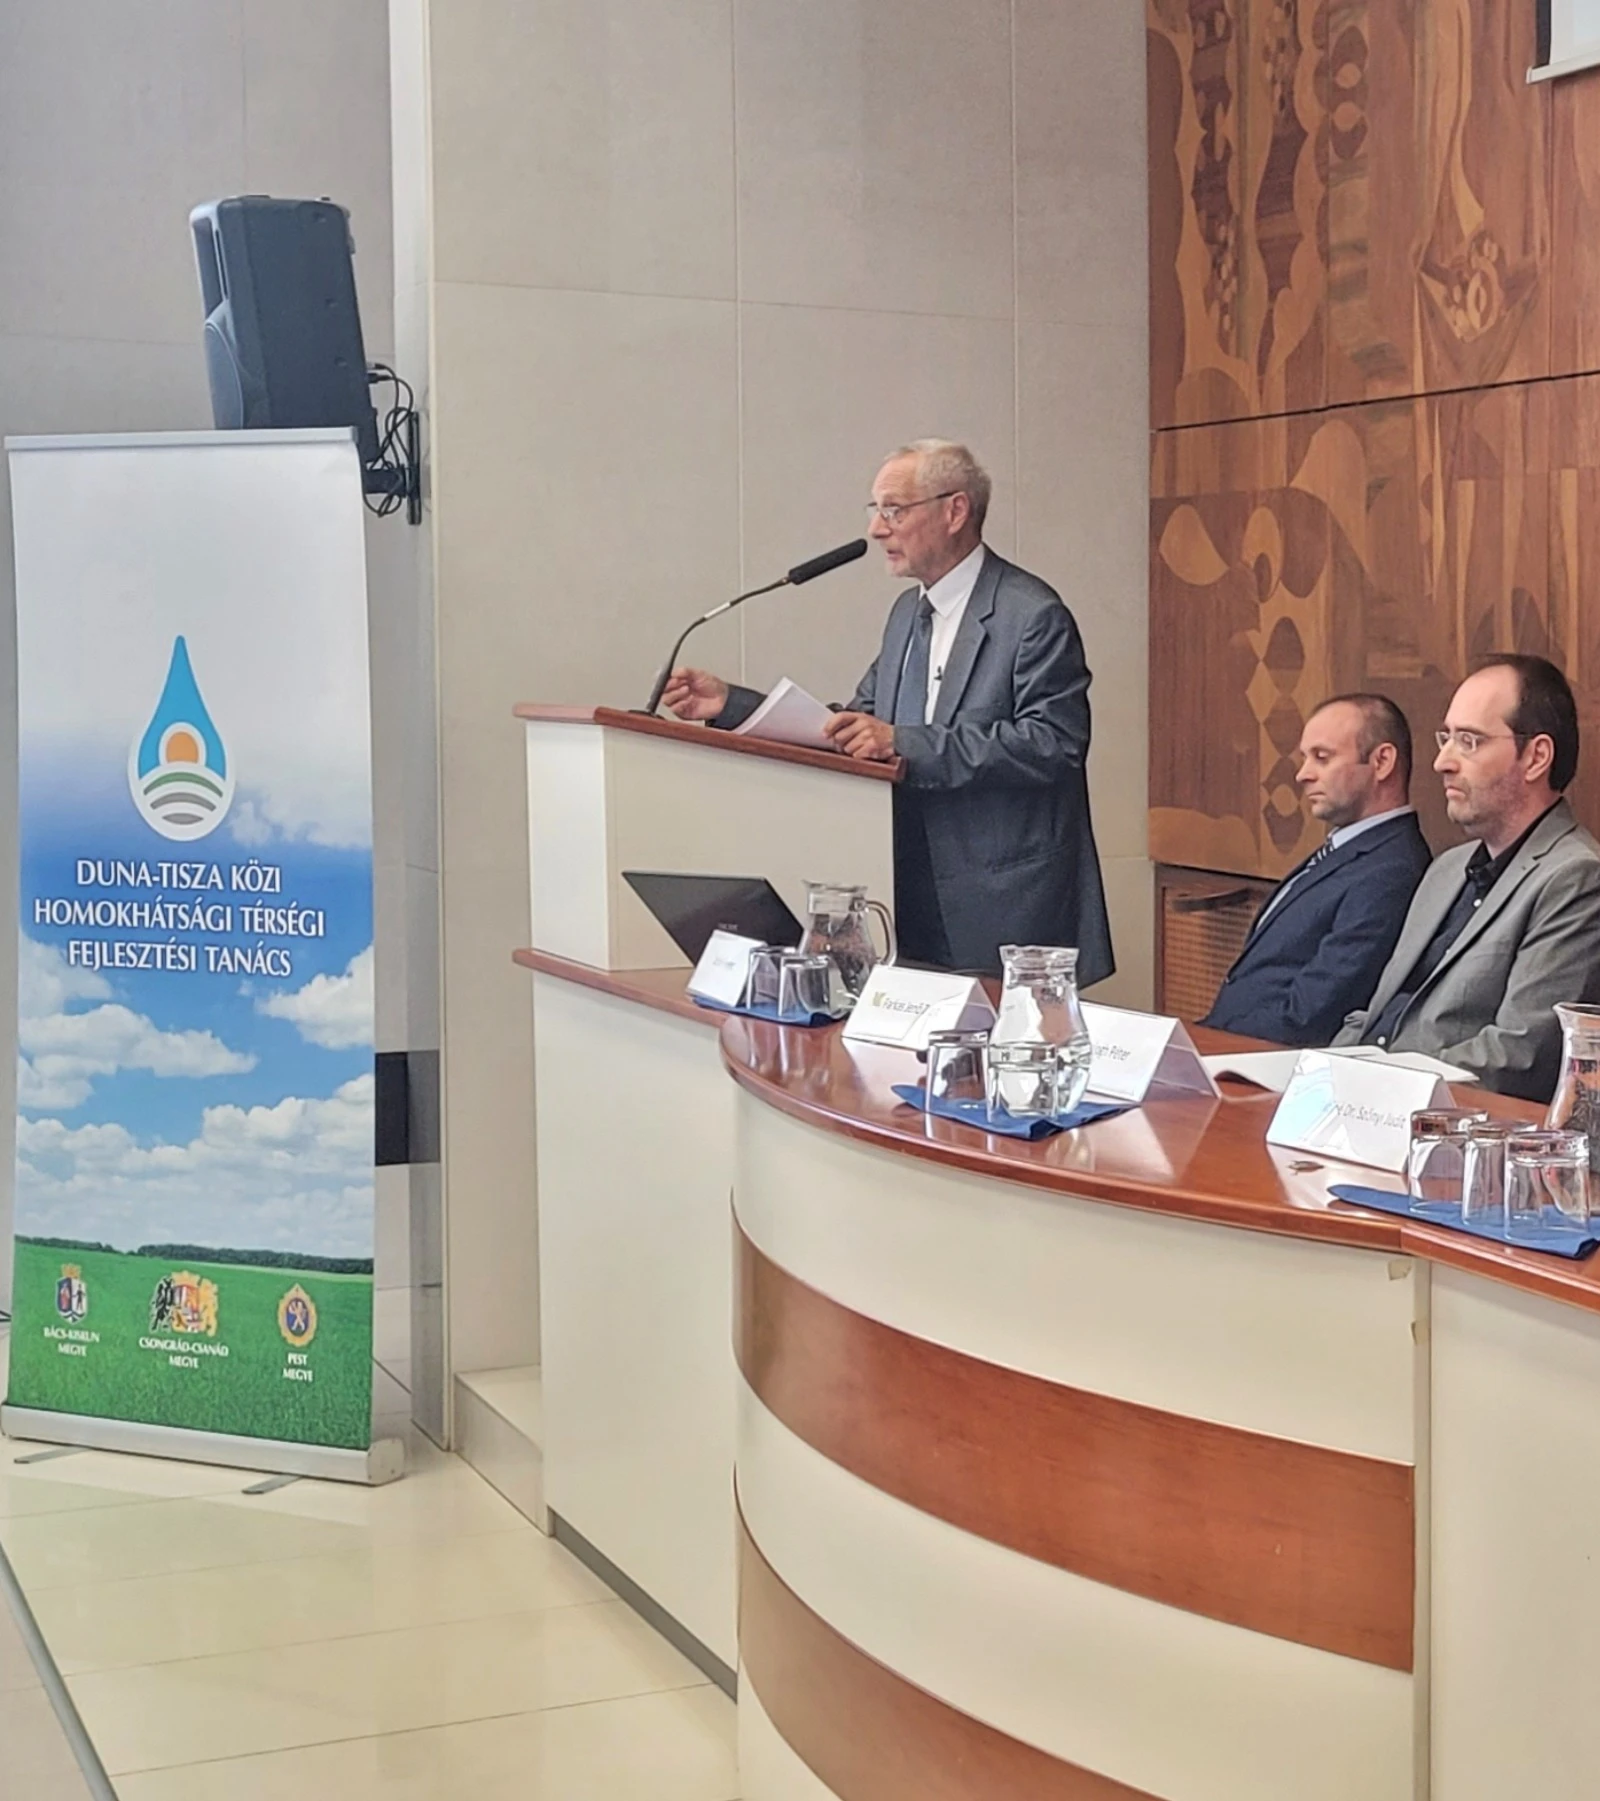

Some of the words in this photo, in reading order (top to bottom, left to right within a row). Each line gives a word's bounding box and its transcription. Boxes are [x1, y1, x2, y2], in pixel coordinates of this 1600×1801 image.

[76, 859, 224, 891] DUNA-TISZA
[231, 861, 281, 893] KÖZI
[34, 896, 232, 932] HOMOKHÁTSÁGI
[240, 899, 325, 937] TÉRSÉGI
[68, 937, 196, 972] FEJLESZTÉSI
[204, 941, 291, 977] TANÁCS
[58, 1343, 87, 1357] MEGYE
[168, 1355, 199, 1369] MEGYE
[287, 1352, 308, 1366] PEST
[282, 1367, 313, 1382] MEGYE
